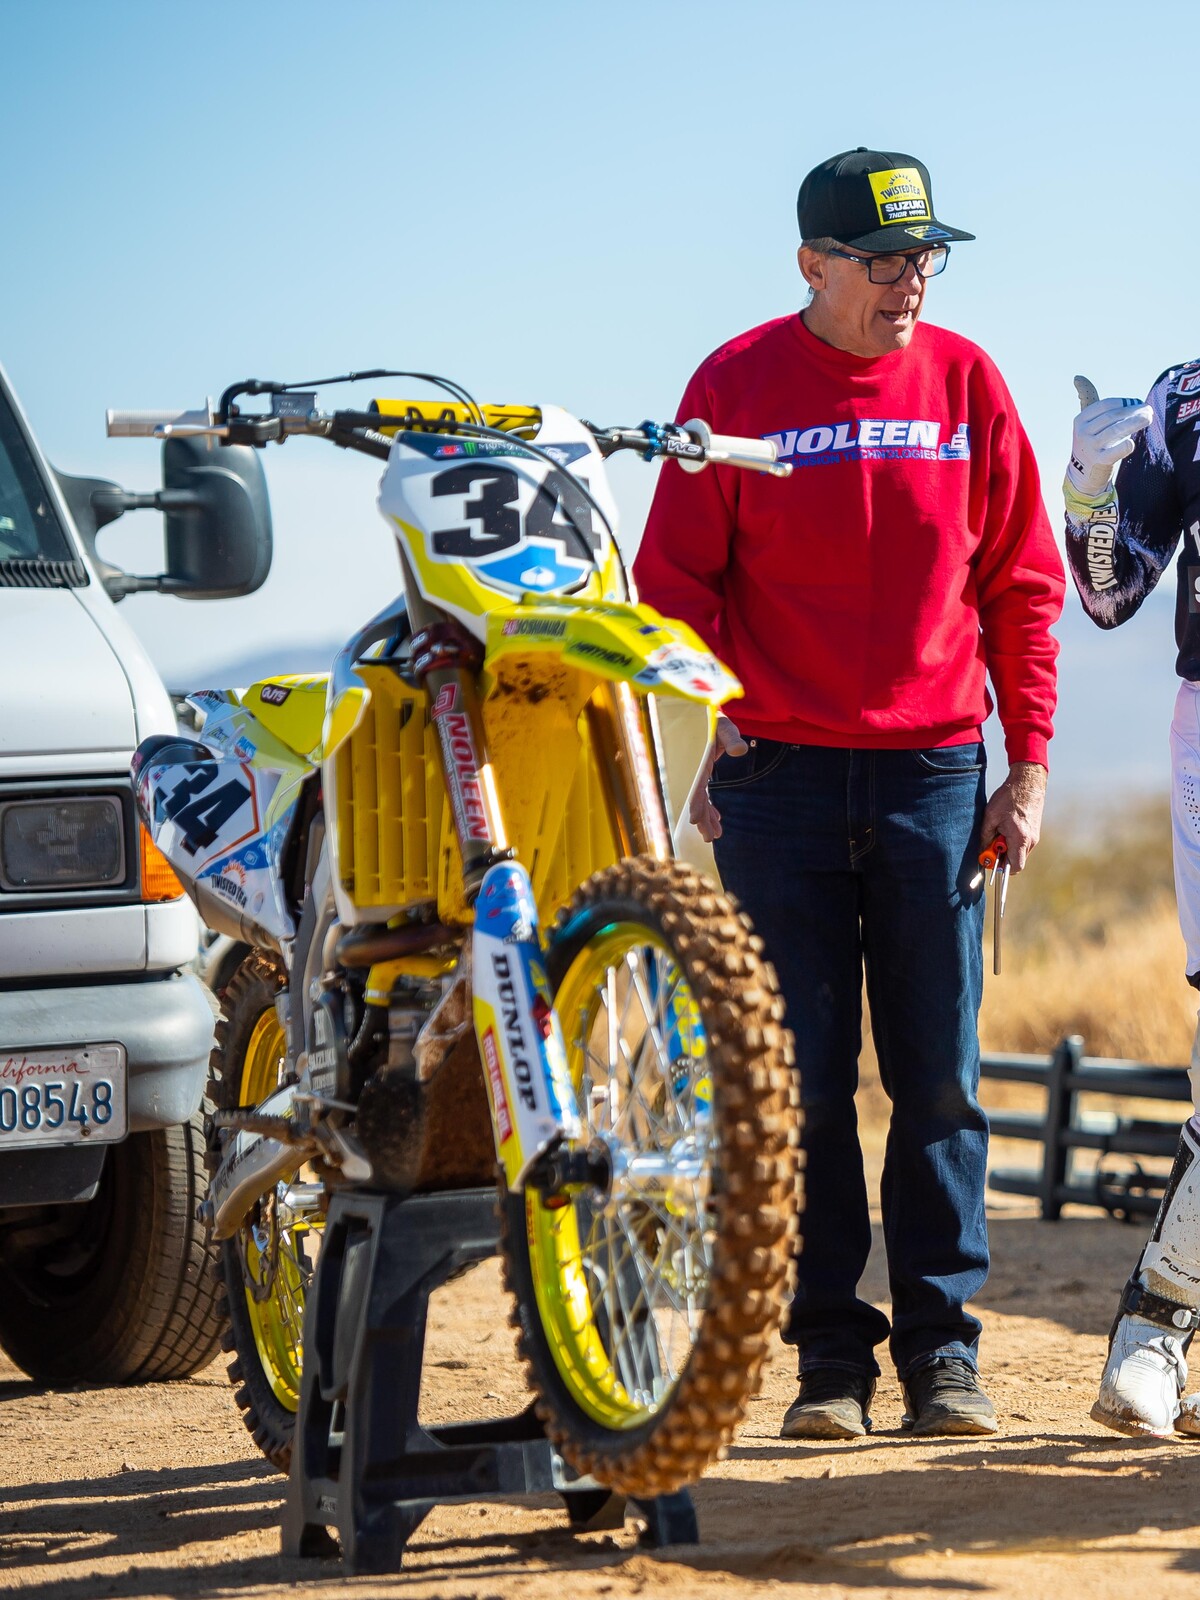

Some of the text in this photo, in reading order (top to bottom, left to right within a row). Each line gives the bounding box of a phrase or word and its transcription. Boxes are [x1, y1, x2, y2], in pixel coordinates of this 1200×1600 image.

[885, 200, 925, 213] SUZUKI
[762, 420, 939, 458] NOLEEN
[430, 461, 602, 560] 34
[446, 714, 490, 840] NOLEEN
[491, 952, 537, 1112] DUNLOP
[0, 1056, 91, 1085] lifornia
[0, 1081, 113, 1131] 08548
